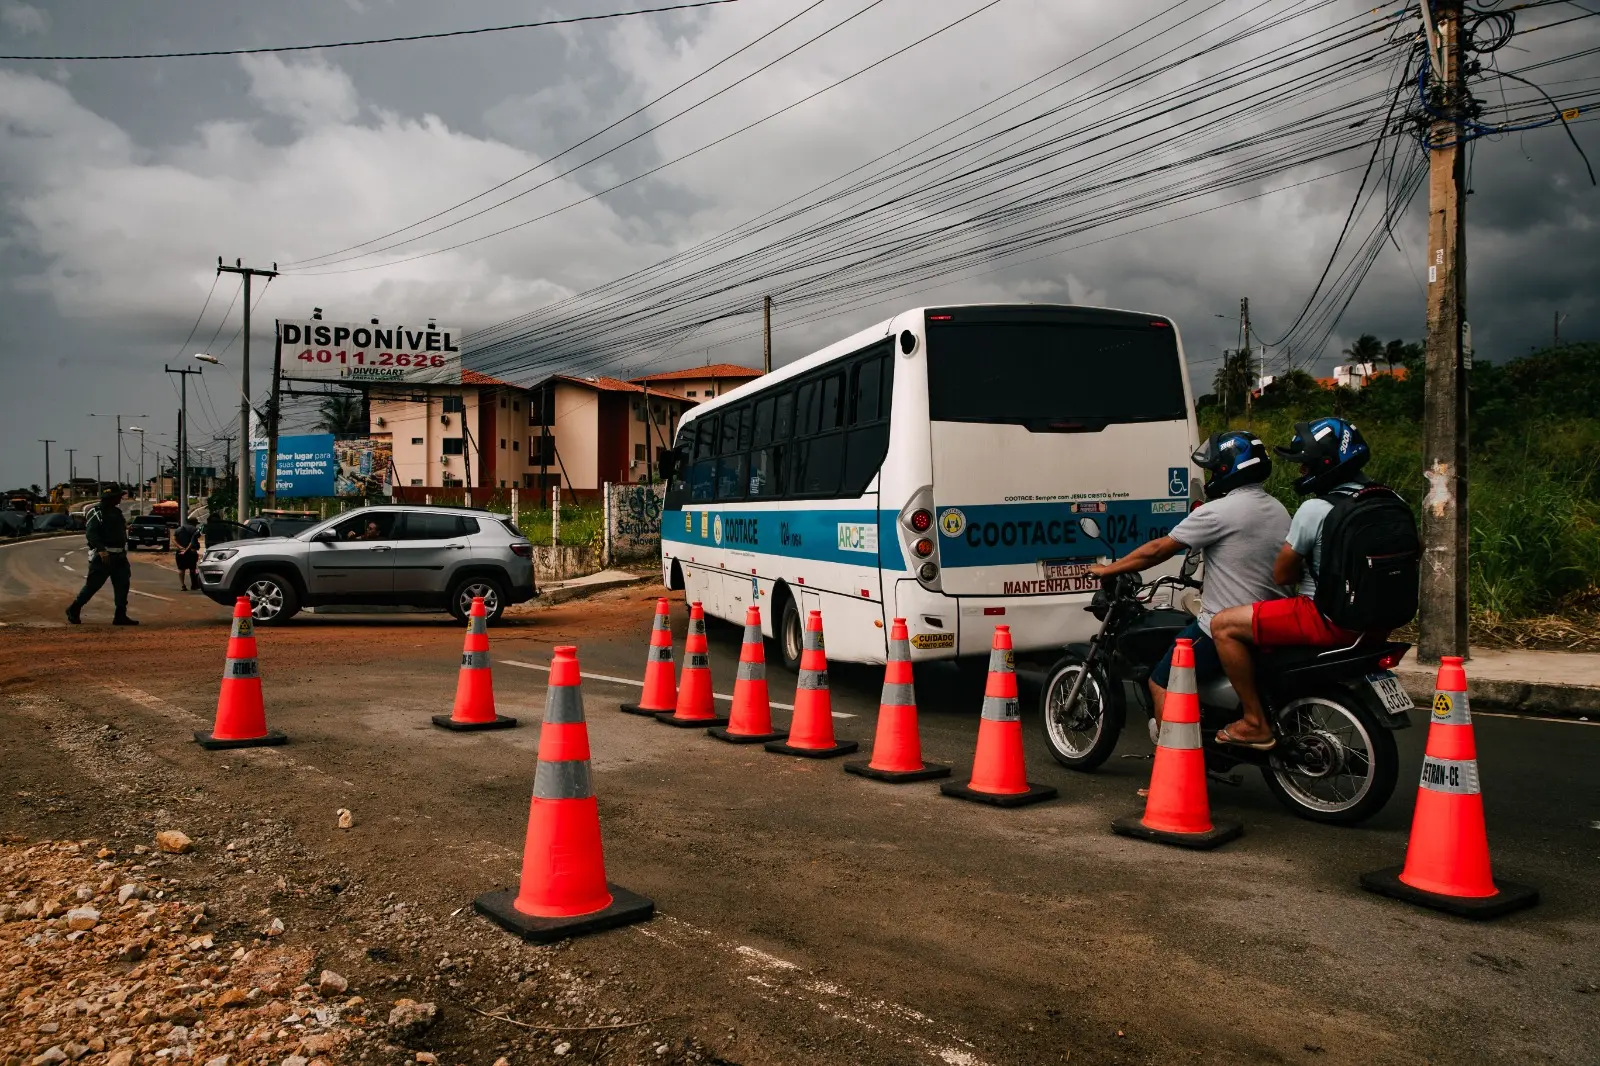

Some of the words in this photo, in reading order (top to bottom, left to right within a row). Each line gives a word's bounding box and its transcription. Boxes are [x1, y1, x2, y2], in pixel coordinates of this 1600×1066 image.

[283, 324, 458, 352] DISPONÍVEL
[298, 349, 445, 368] 4011.2626
[353, 367, 404, 376] DIVULCART
[294, 452, 313, 461] lugar
[295, 460, 327, 468] compras
[294, 467, 324, 476] Vizinho.
[1152, 502, 1176, 512] ARCE
[725, 518, 759, 545] COOTACE
[839, 525, 865, 549] ARCE
[966, 519, 1077, 548] COOTACE
[1107, 513, 1138, 543] 024
[1004, 578, 1071, 595] MANTENHA
[1379, 678, 1398, 696] HXP
